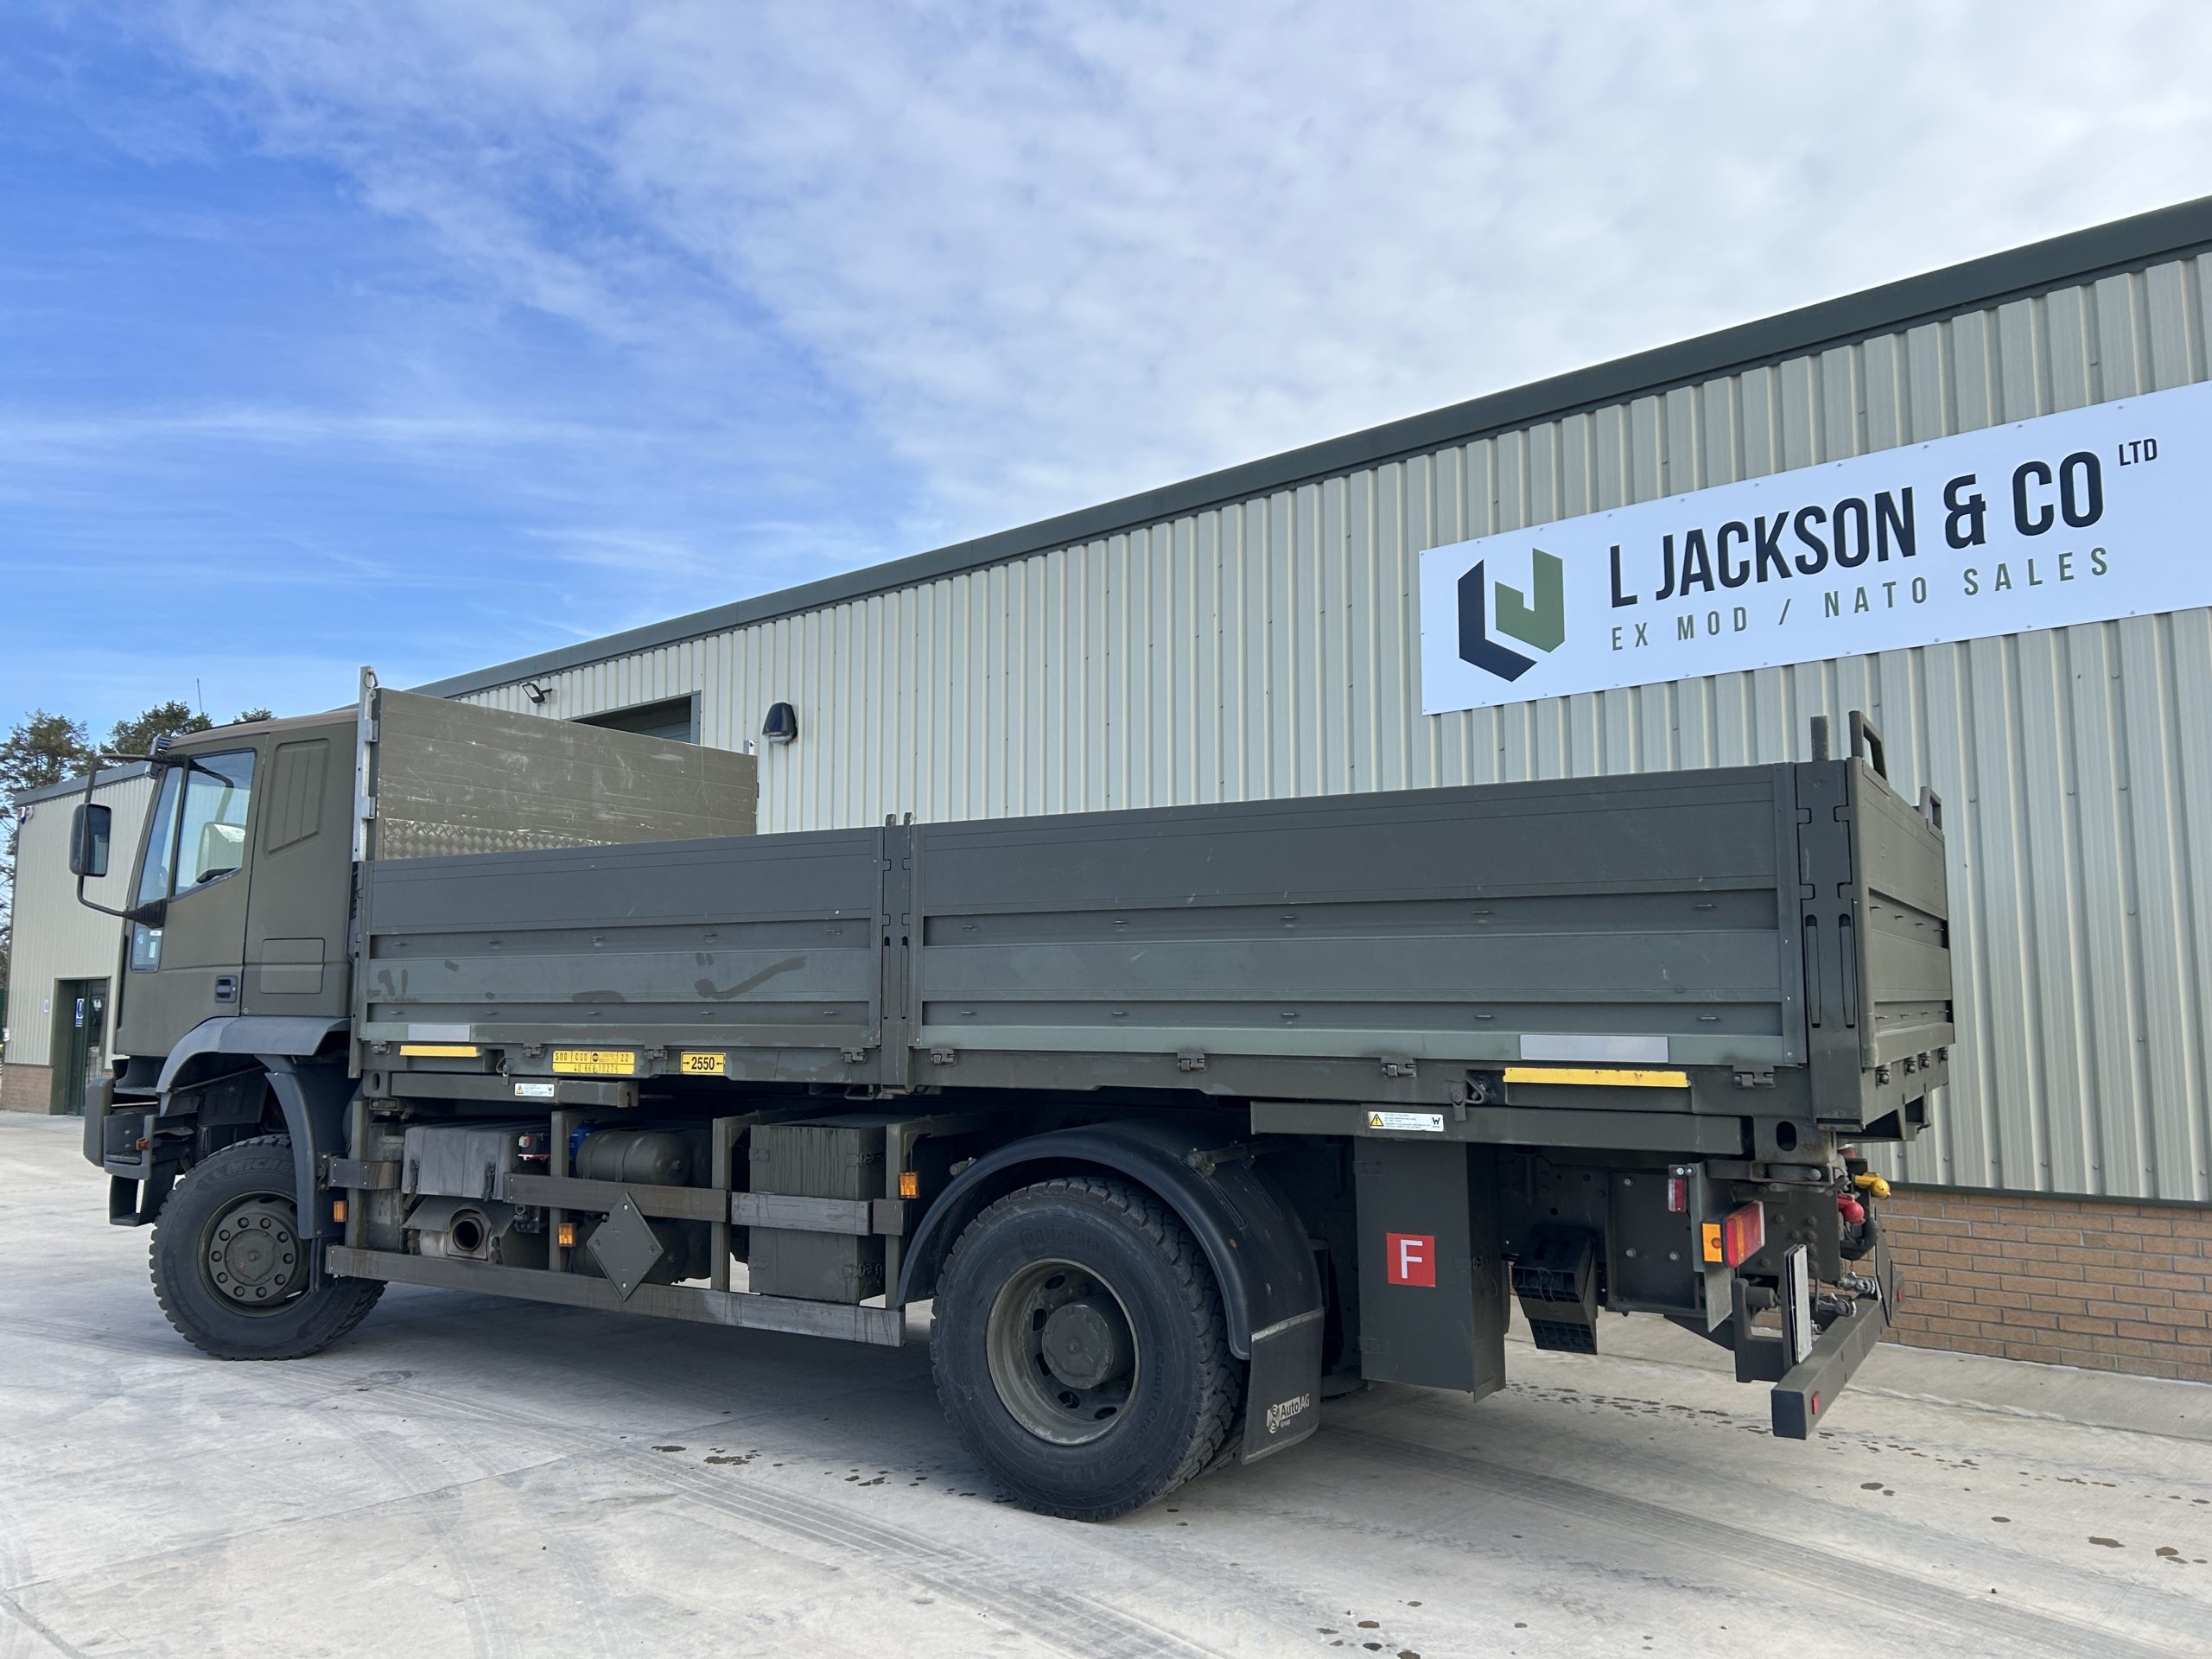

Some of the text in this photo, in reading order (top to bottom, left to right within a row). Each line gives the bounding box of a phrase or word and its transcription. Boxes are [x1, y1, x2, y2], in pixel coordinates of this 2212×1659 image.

[1610, 438, 2158, 608] L JACKSON & CO LTD
[1611, 547, 2108, 651] EX MOD / NATO SALES
[691, 1056, 715, 1071] 2550
[1401, 1239, 1423, 1279] F
